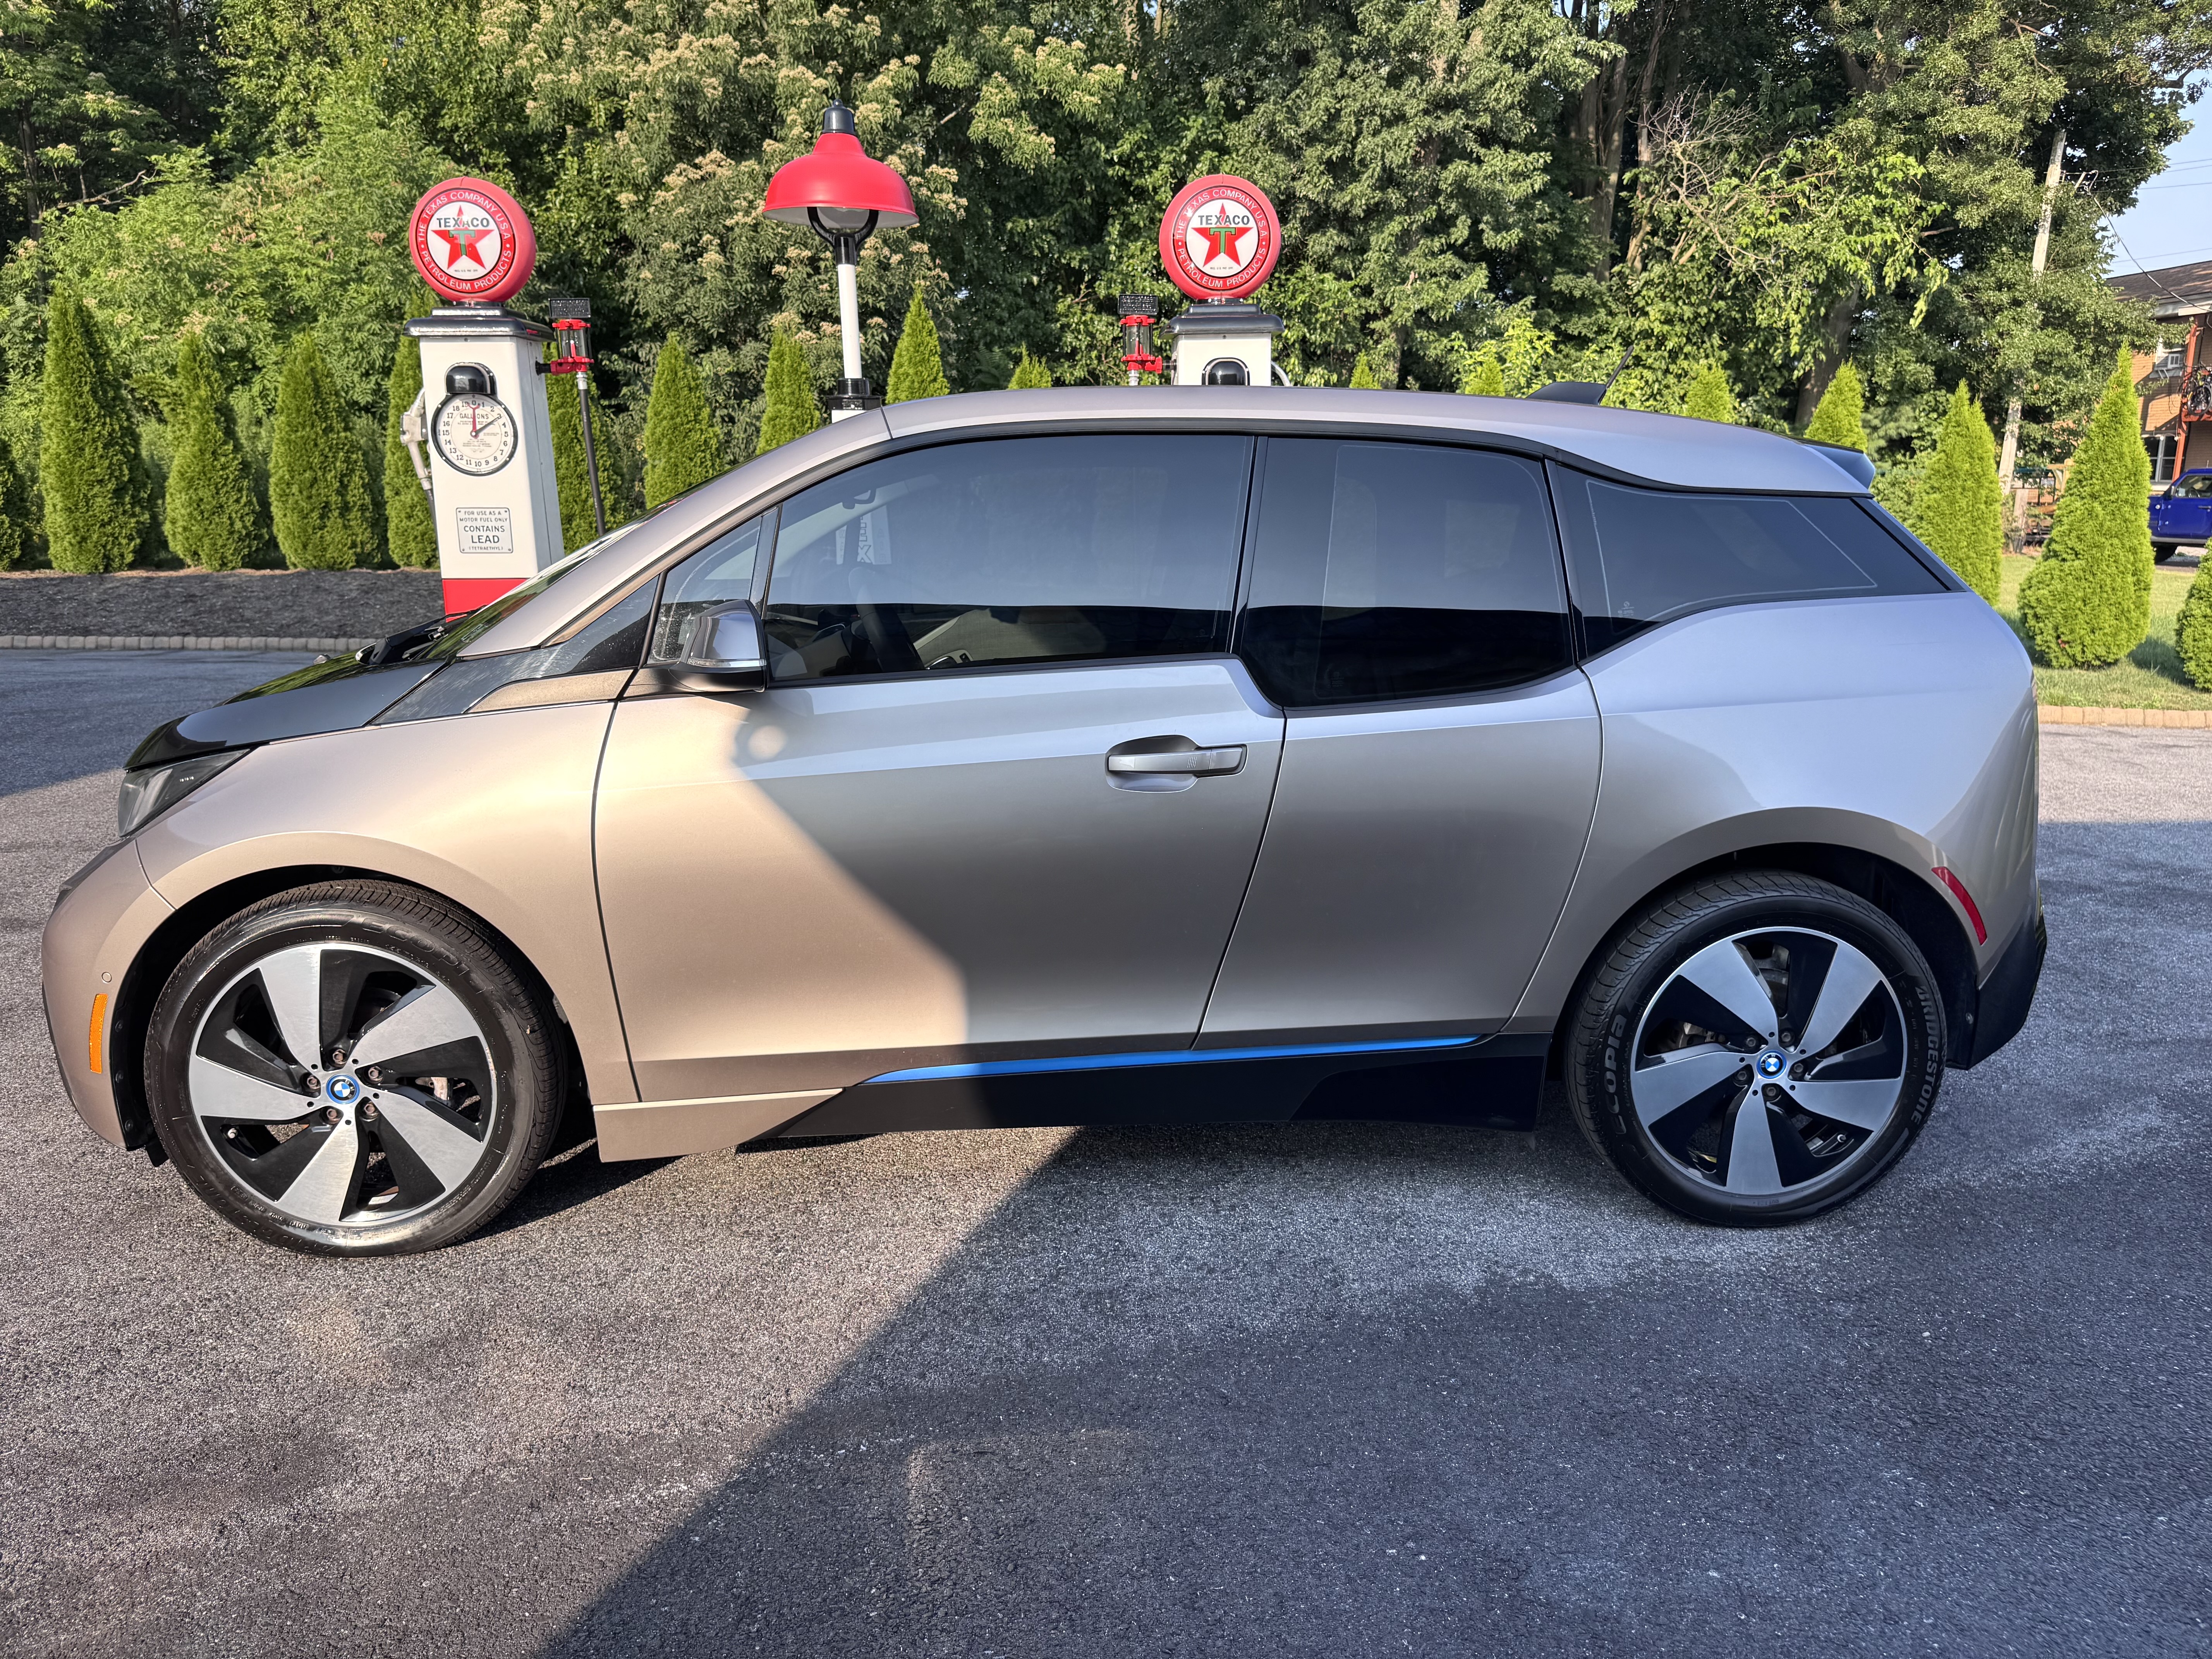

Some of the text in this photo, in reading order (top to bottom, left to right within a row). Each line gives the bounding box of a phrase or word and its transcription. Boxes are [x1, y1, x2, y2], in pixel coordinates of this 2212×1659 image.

[423, 195, 447, 219] TEXAS
[450, 191, 498, 213] COMPANY
[1177, 219, 1185, 239] THE
[1212, 189, 1257, 210] COMPANY
[1198, 215, 1250, 225] TEXACO
[436, 217, 490, 228] TEXACO
[421, 251, 511, 290] PETROLEUM PRODUCTS
[1177, 248, 1266, 287] PETROLEUM PRODUCTS
[471, 535, 500, 543] LEAD
[1911, 986, 1939, 1124] BRIDGESTONE
